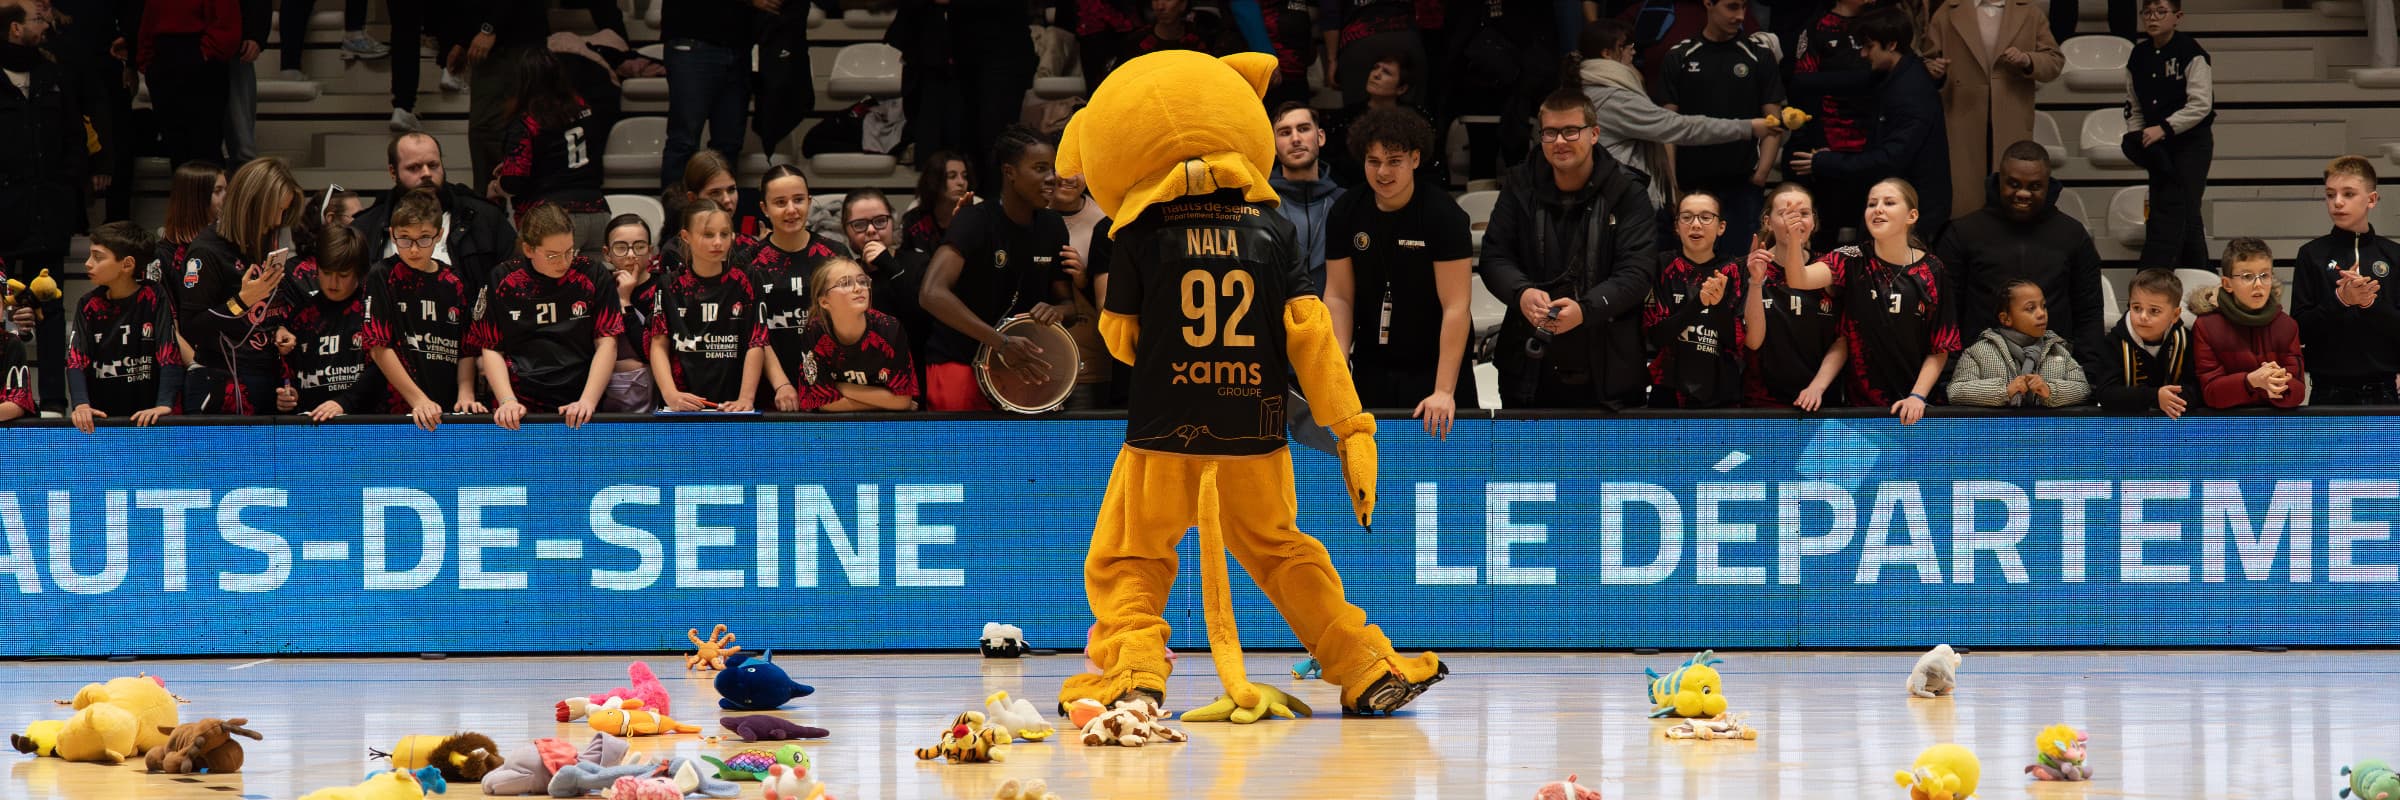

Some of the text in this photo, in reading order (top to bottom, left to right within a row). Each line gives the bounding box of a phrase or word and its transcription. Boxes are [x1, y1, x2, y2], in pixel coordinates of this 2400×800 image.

[564, 126, 589, 168] 6
[1186, 228, 1239, 256] NALA
[791, 277, 803, 296] 4
[420, 299, 437, 321] 14
[536, 302, 557, 324] 21
[701, 303, 719, 323] 10
[1181, 269, 1255, 347] 92
[1790, 295, 1802, 315] 4
[1889, 293, 1902, 314] 3
[119, 324, 130, 345] 7
[319, 334, 340, 356] 20
[1217, 387, 1262, 398] GROUPE
[1415, 451, 2400, 585] LE DÉPARTEME
